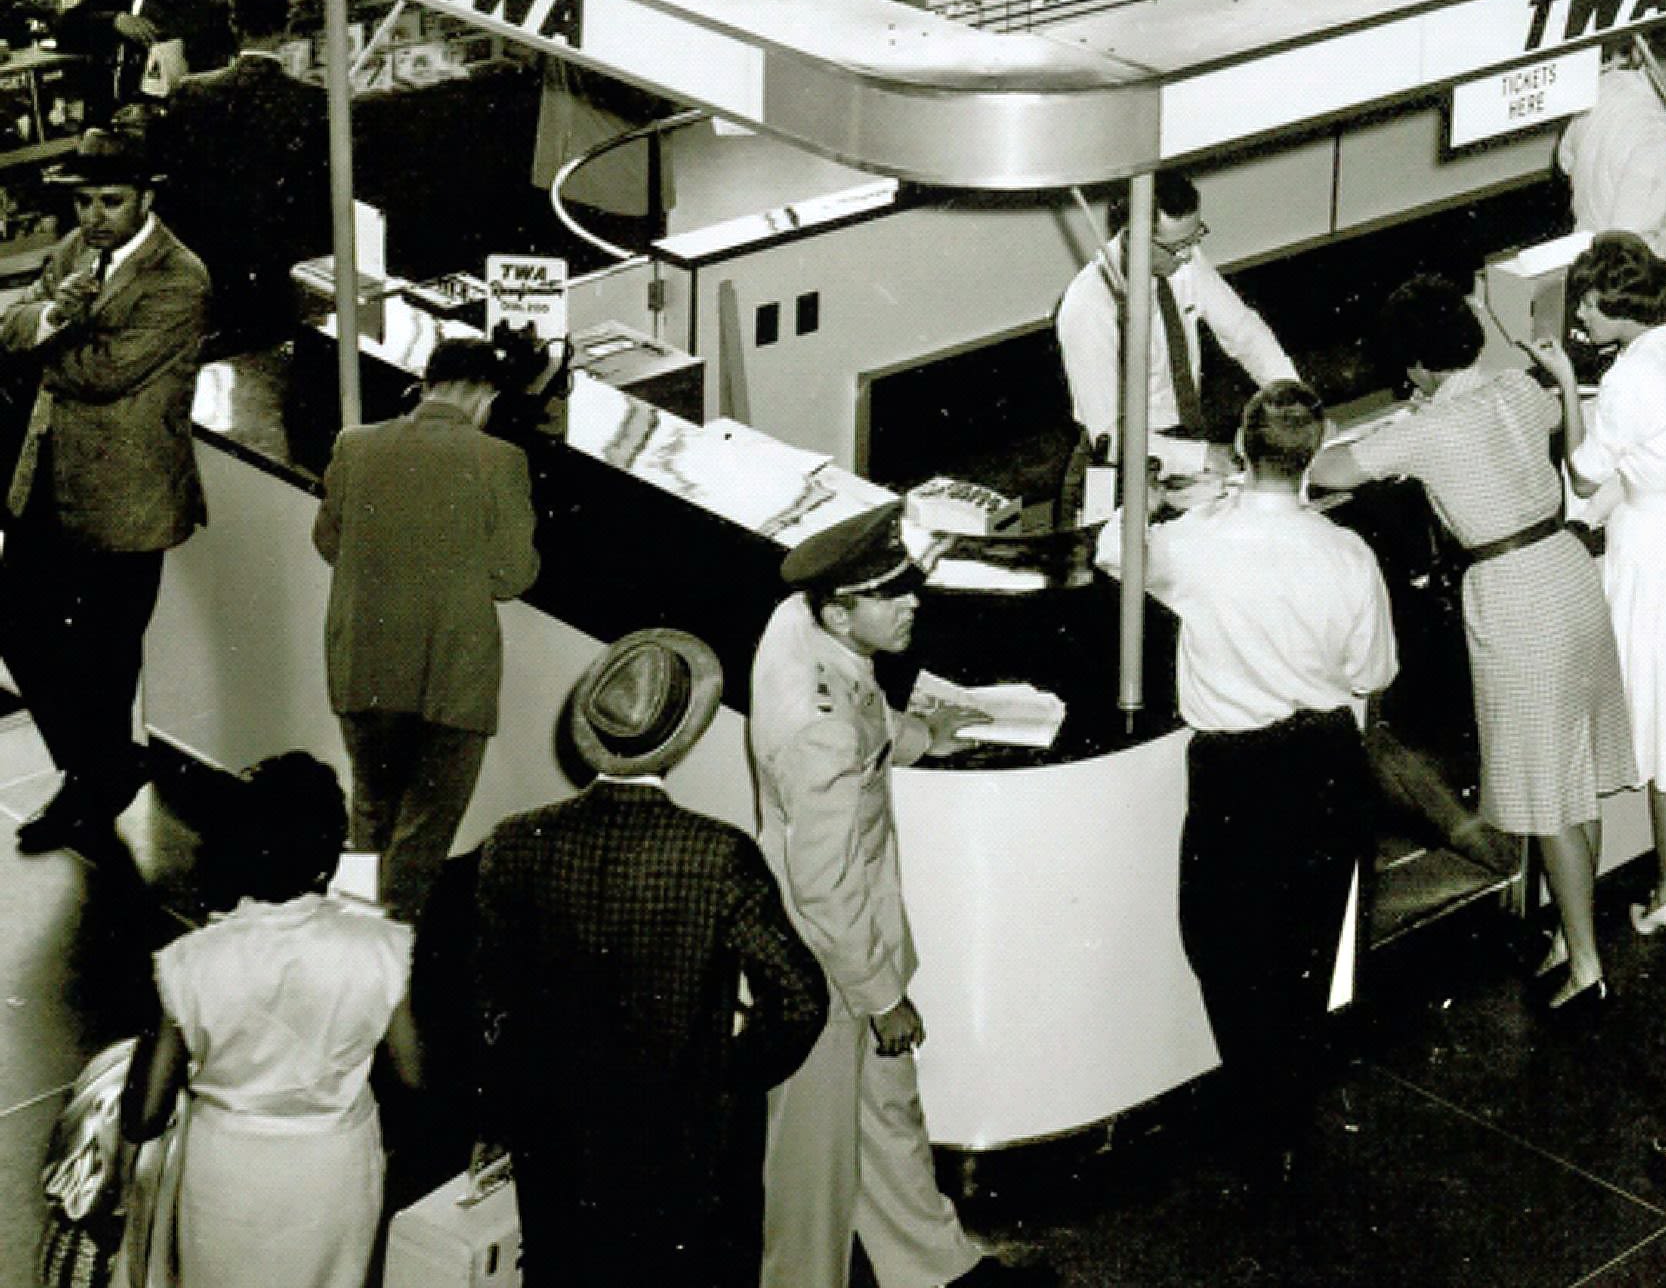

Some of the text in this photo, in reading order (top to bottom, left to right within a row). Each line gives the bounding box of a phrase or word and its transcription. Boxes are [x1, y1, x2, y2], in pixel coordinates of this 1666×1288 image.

[1502, 63, 1557, 97] TICKETS
[1509, 91, 1545, 119] HERE
[500, 264, 547, 281] TWA
